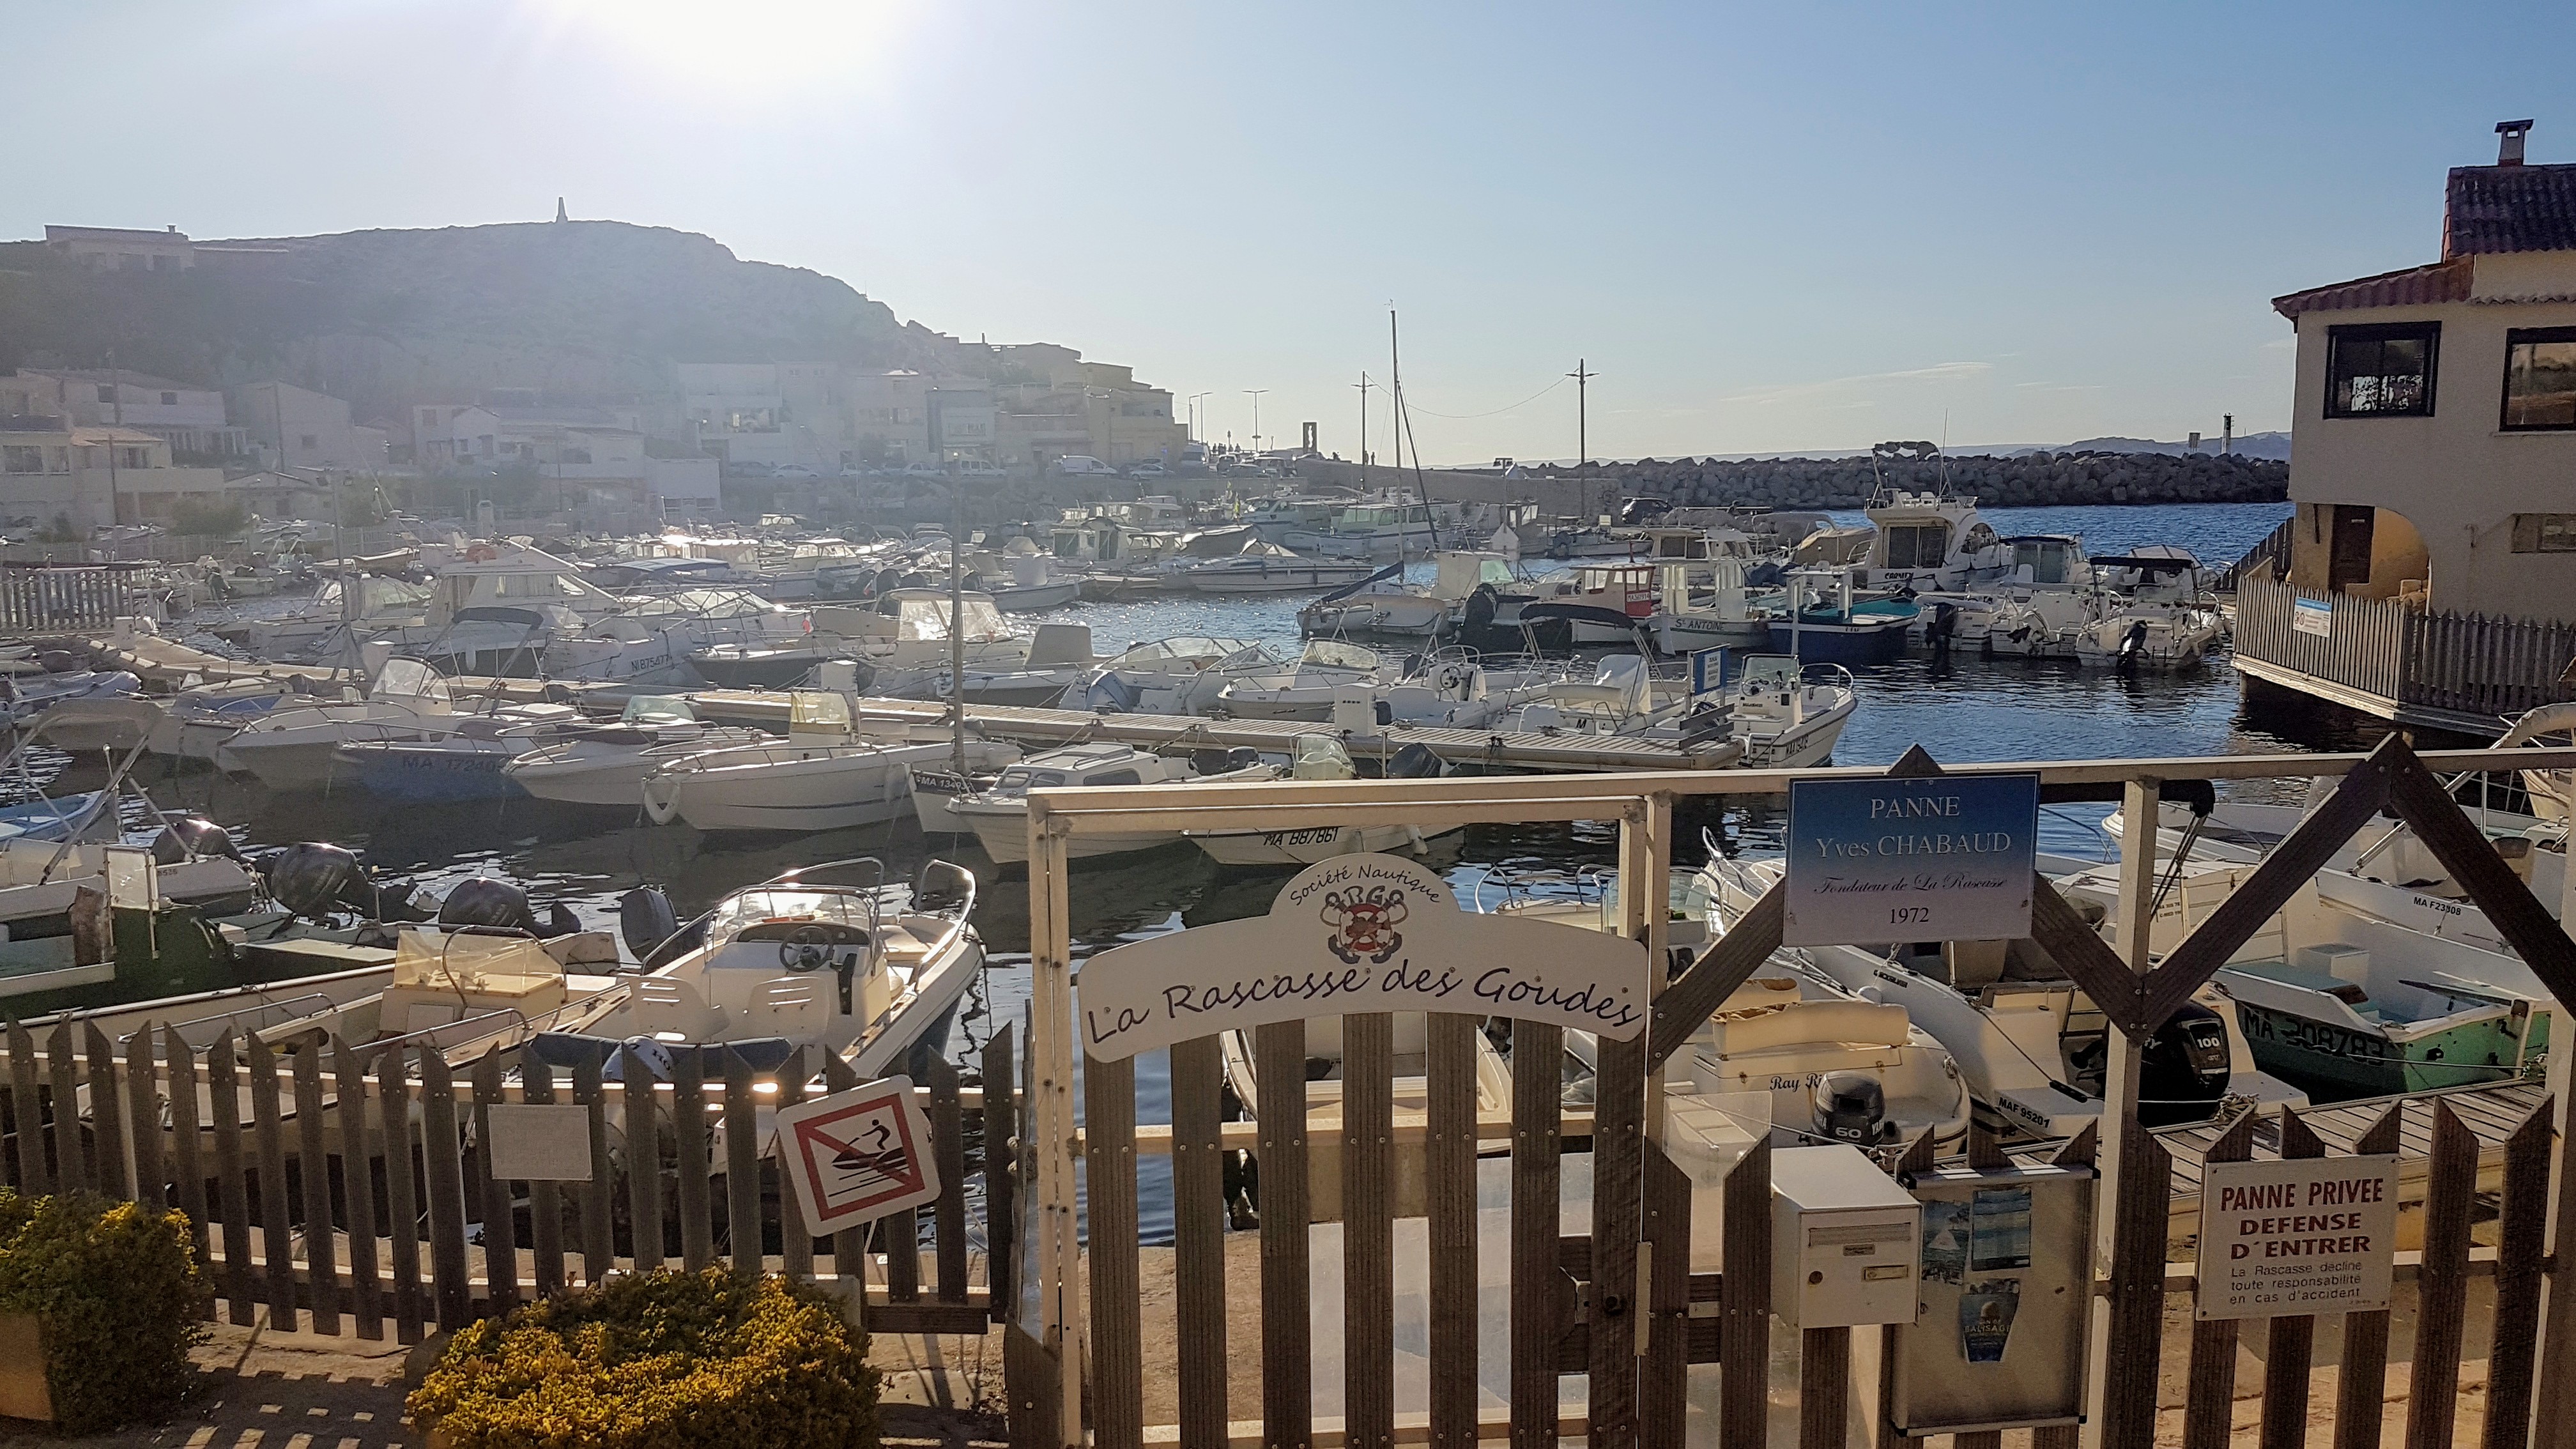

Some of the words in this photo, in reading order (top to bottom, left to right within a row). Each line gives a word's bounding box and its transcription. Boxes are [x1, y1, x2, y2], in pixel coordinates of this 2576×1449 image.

[1688, 621, 1725, 631] ANTOINE
[921, 777, 937, 786] MA
[1871, 797, 1960, 819] PANNE
[1263, 833, 1284, 845] MA
[1816, 838, 1870, 857] Yves
[1877, 832, 2011, 856] CHABAUD
[1290, 865, 1353, 906] Société
[1358, 864, 1440, 903] Nautique
[1814, 877, 1889, 894] Fondateur
[1891, 877, 1907, 891] de
[1913, 873, 1938, 891] La
[1942, 871, 2007, 889] Rascasse
[2413, 896, 2427, 907] MA
[1890, 907, 1929, 924] 1972
[1088, 1008, 1150, 1044] La
[1162, 967, 1370, 1019] Rascasse
[1381, 958, 1463, 998] des
[1473, 967, 1643, 1027] Goudes
[2243, 1008, 2275, 1041] MA
[2196, 1037, 2220, 1048] 100
[1769, 1075, 1800, 1092] Ray
[1805, 1073, 1823, 1089] Ri
[1835, 1126, 1862, 1138] 60
[2221, 1183, 2296, 1211] PANNE
[2308, 1178, 2383, 1206] PRIVEE
[2239, 1213, 2361, 1236] DEFENSE
[2232, 1268, 2246, 1277] La
[2255, 1264, 2313, 1276] Rascasse
[2231, 1280, 2264, 1291] toute
[2230, 1295, 2246, 1305] en
[2255, 1293, 2278, 1303] cas
[2288, 1287, 2360, 1301] d'accident
